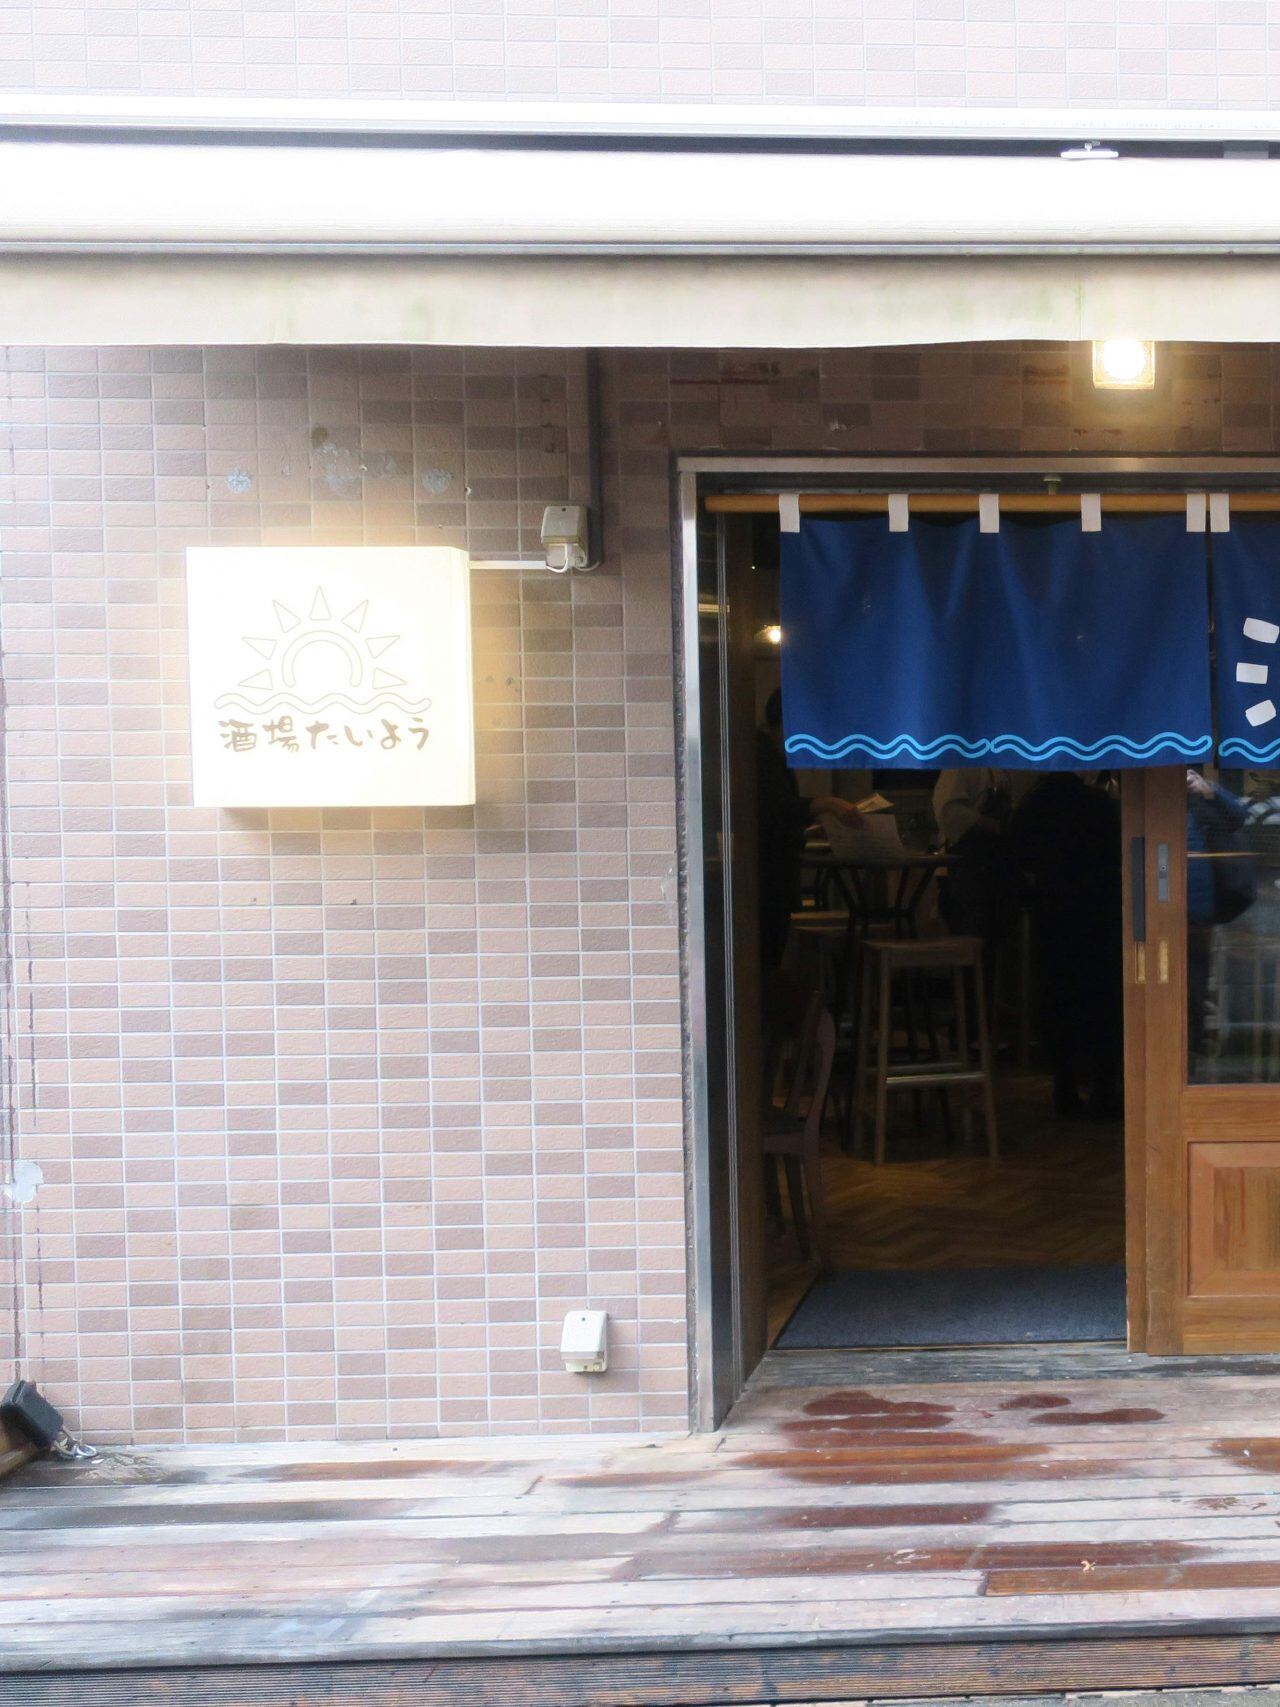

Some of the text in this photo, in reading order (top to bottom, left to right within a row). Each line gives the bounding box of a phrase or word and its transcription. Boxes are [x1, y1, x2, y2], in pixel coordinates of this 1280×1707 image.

[219, 716, 430, 752] 酒場たいよう
